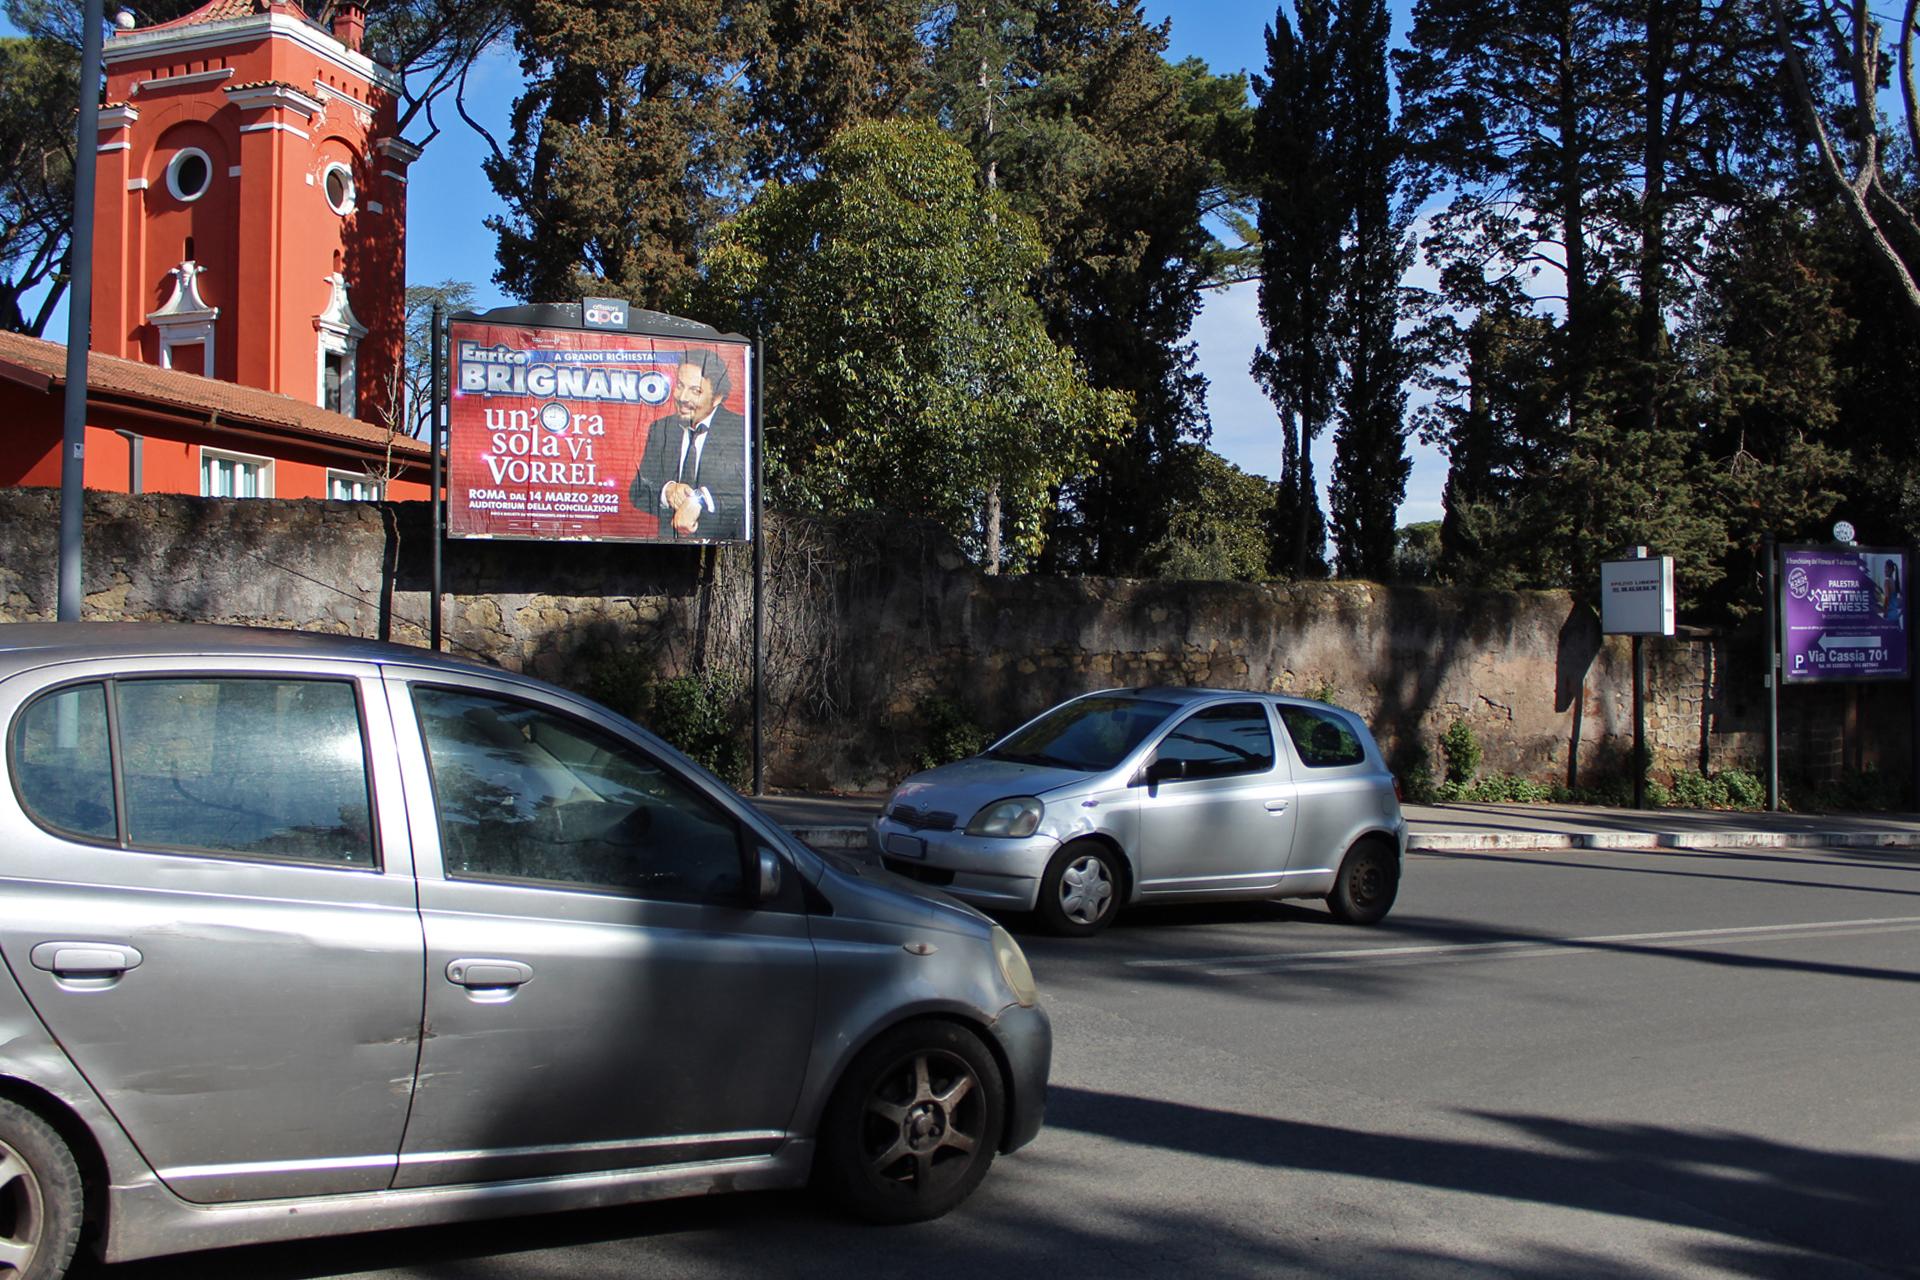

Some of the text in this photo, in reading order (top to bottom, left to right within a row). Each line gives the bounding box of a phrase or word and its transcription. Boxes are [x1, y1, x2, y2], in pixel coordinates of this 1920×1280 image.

[461, 342, 526, 364] Enrico
[554, 352, 562, 361] A
[564, 352, 603, 361] GRANDI
[461, 363, 668, 404] BRIGNANO
[491, 425, 560, 457] sola
[468, 489, 619, 504] ROMA DAL 14 MARZO 2022
[468, 501, 619, 513] AUDITORIUM DELLA CONCILIAZIONE
[1828, 580, 1860, 588] PALESTRA
[1821, 589, 1870, 602] ANYTIME
[1822, 602, 1870, 612] FITNESS
[1808, 649, 1888, 662] Via Cassia 701
